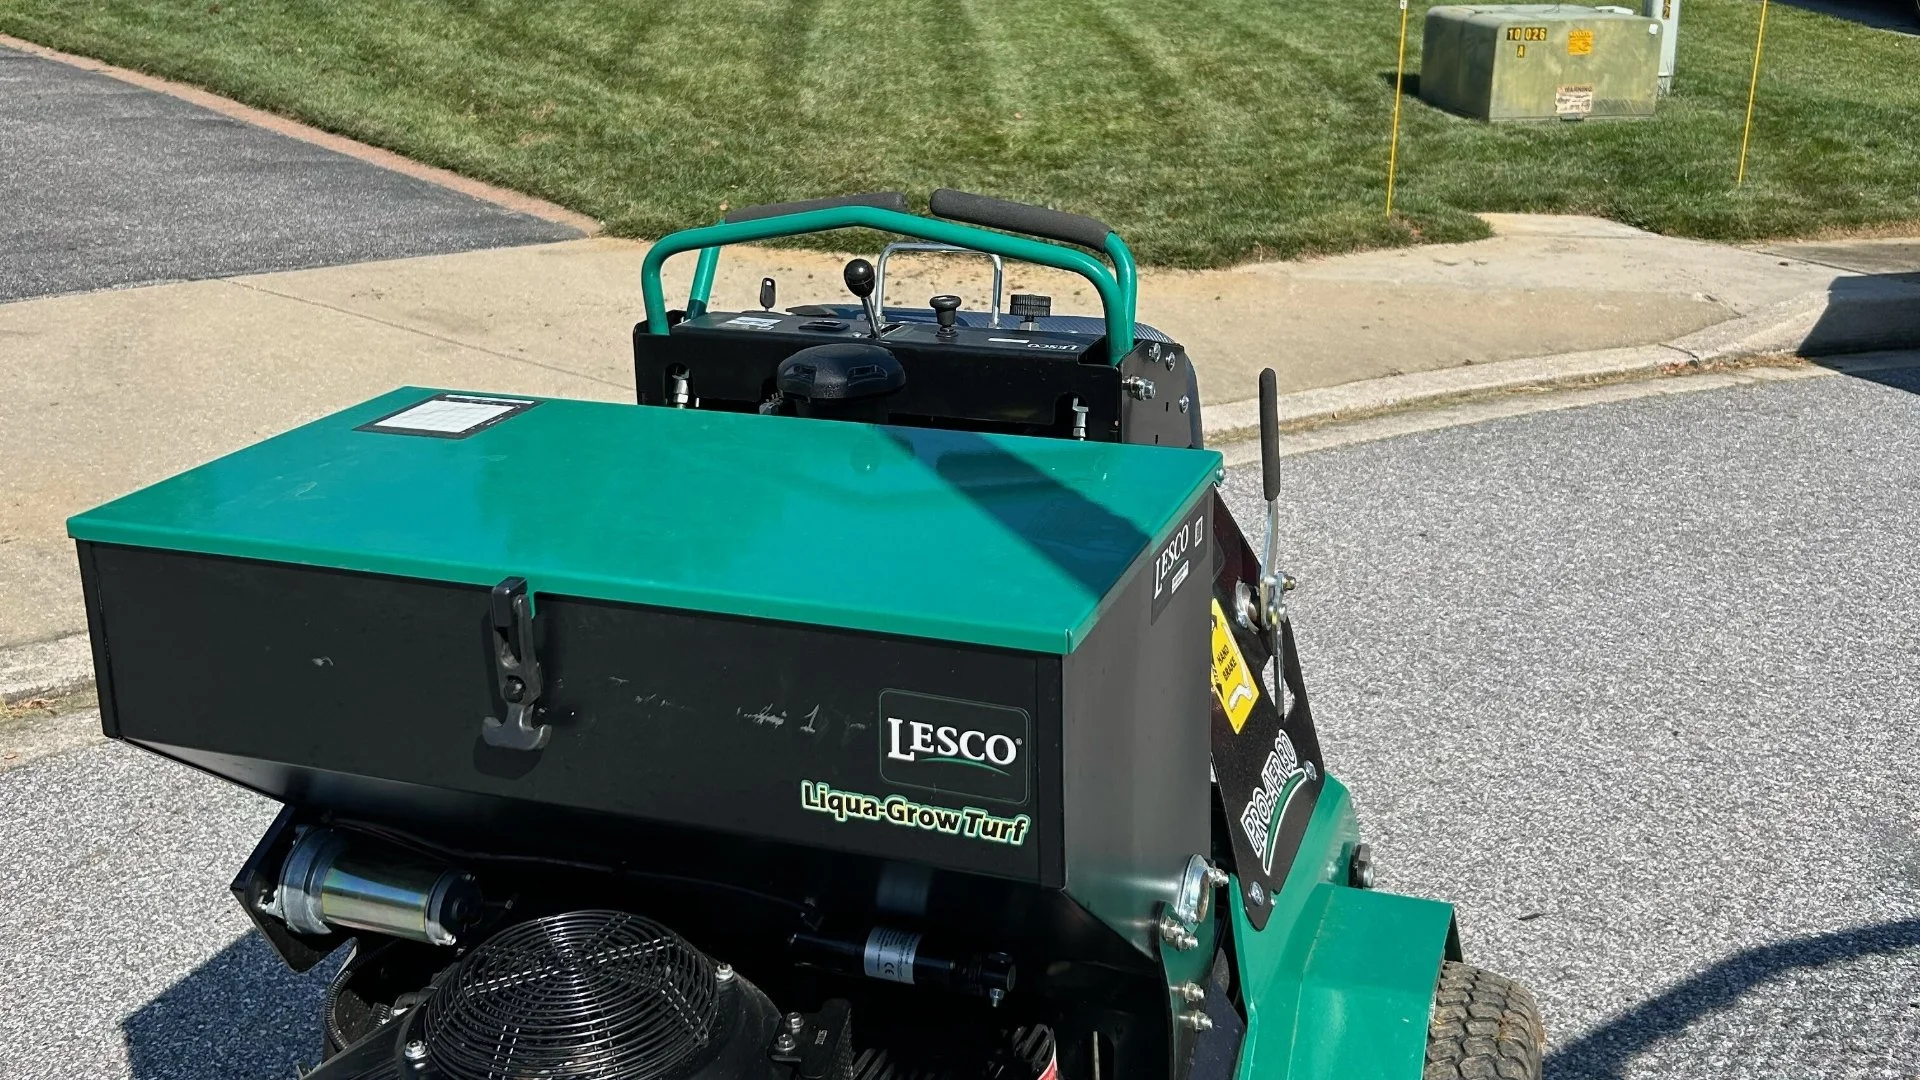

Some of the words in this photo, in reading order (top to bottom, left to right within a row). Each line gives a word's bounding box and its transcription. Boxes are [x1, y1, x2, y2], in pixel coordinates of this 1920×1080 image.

[1508, 28, 1521, 40] 10
[1216, 644, 1230, 665] HAND
[1222, 656, 1237, 681] BRAKE
[801, 780, 962, 835] Liqua-Grow
[963, 805, 1030, 845] Turf
